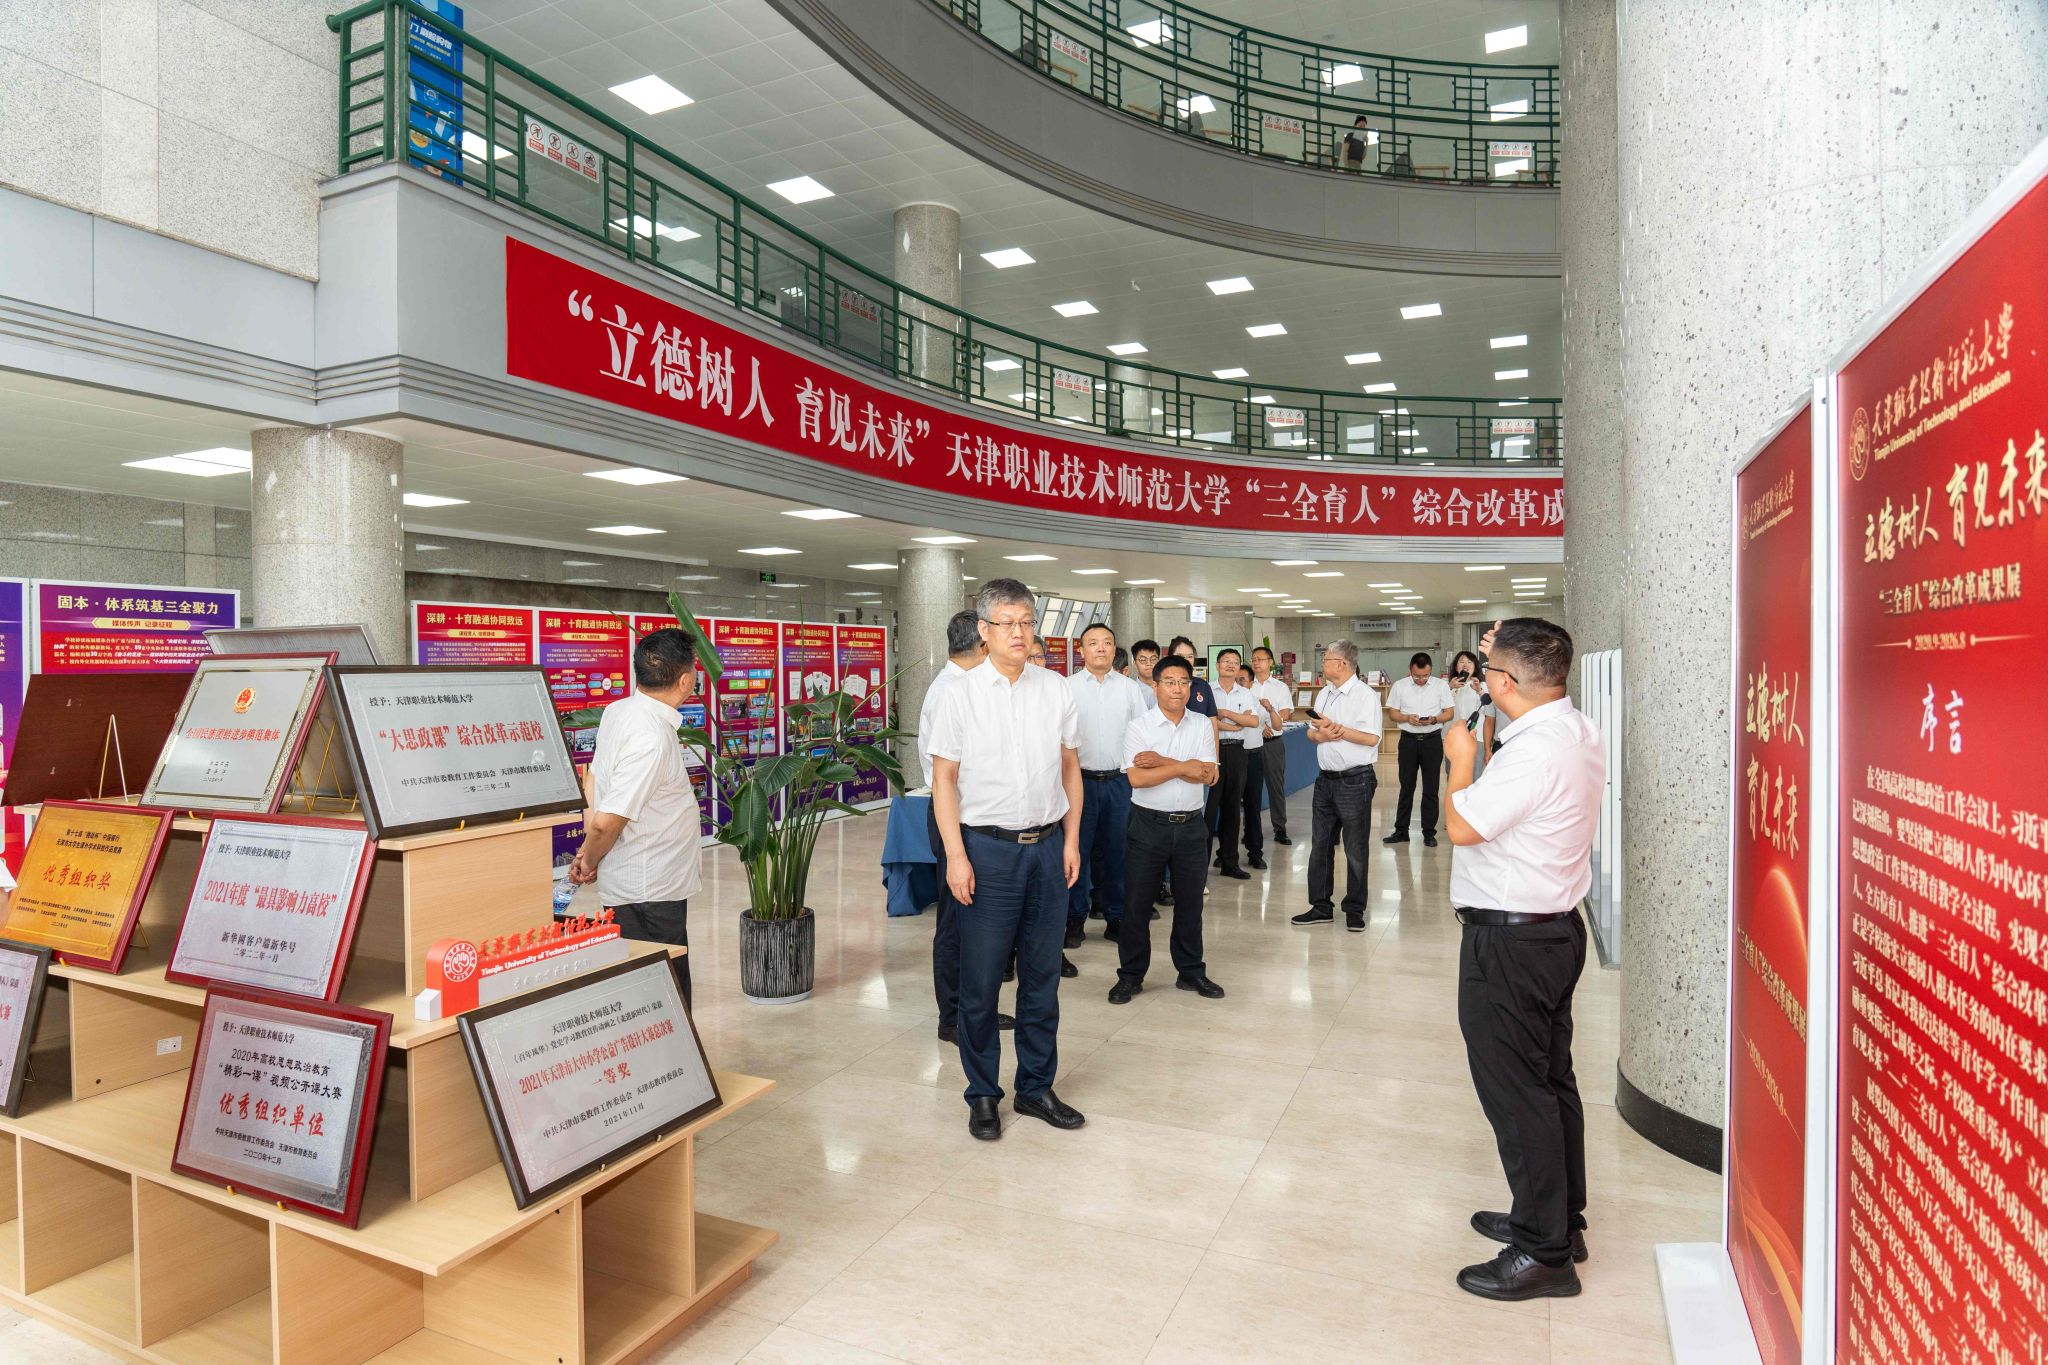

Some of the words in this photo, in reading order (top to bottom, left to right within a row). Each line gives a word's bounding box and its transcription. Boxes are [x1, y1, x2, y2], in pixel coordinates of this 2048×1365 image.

[568, 289, 775, 427] “立德树人
[794, 377, 930, 467] 育见未来”
[946, 431, 1231, 515] 天津职业技术师范大学
[1246, 478, 1395, 524] “三全育人”
[1890, 428, 1916, 453] University
[1917, 421, 1923, 436] of
[1923, 403, 1958, 432] Technology
[1959, 390, 1972, 412] and
[1972, 370, 2011, 403] Education
[1864, 486, 1939, 563] 立德树人
[1746, 661, 1804, 747] 立德树人
[1920, 683, 1964, 754] 序言
[379, 726, 449, 752] “大思政课”
[456, 720, 544, 746] 综合改革示范校
[401, 769, 496, 787] 中共天津市委教育工作委员会
[501, 764, 552, 777] 天津市教育委员会
[43, 863, 112, 891] 优秀组织奖
[204, 880, 250, 907] 2021年度
[254, 885, 338, 917] “最具影响力高校”
[221, 931, 296, 953] 新华网客户端新华号
[481, 964, 504, 976] Tianjin
[505, 955, 537, 970] University
[537, 951, 545, 960] of
[545, 943, 579, 958] Technology
[579, 938, 591, 948] and
[590, 932, 618, 944] Education
[552, 1001, 623, 1035] 天津职业技术师范大学
[231, 1048, 330, 1077] 2020年高校思想政治教育
[592, 1062, 631, 1086] 一等奖
[270, 1075, 342, 1100] 视频公开课大赛
[543, 1091, 632, 1139] 中共天津市委教育工作委员会
[636, 1067, 684, 1096] 天津市教育委员会
[219, 1092, 324, 1137] 优秀组织单位
[603, 1102, 645, 1127] 2021年11月
[215, 1127, 275, 1149] 中共天津市委教育工作委员会
[278, 1143, 318, 1160] 天津市教育委员会
